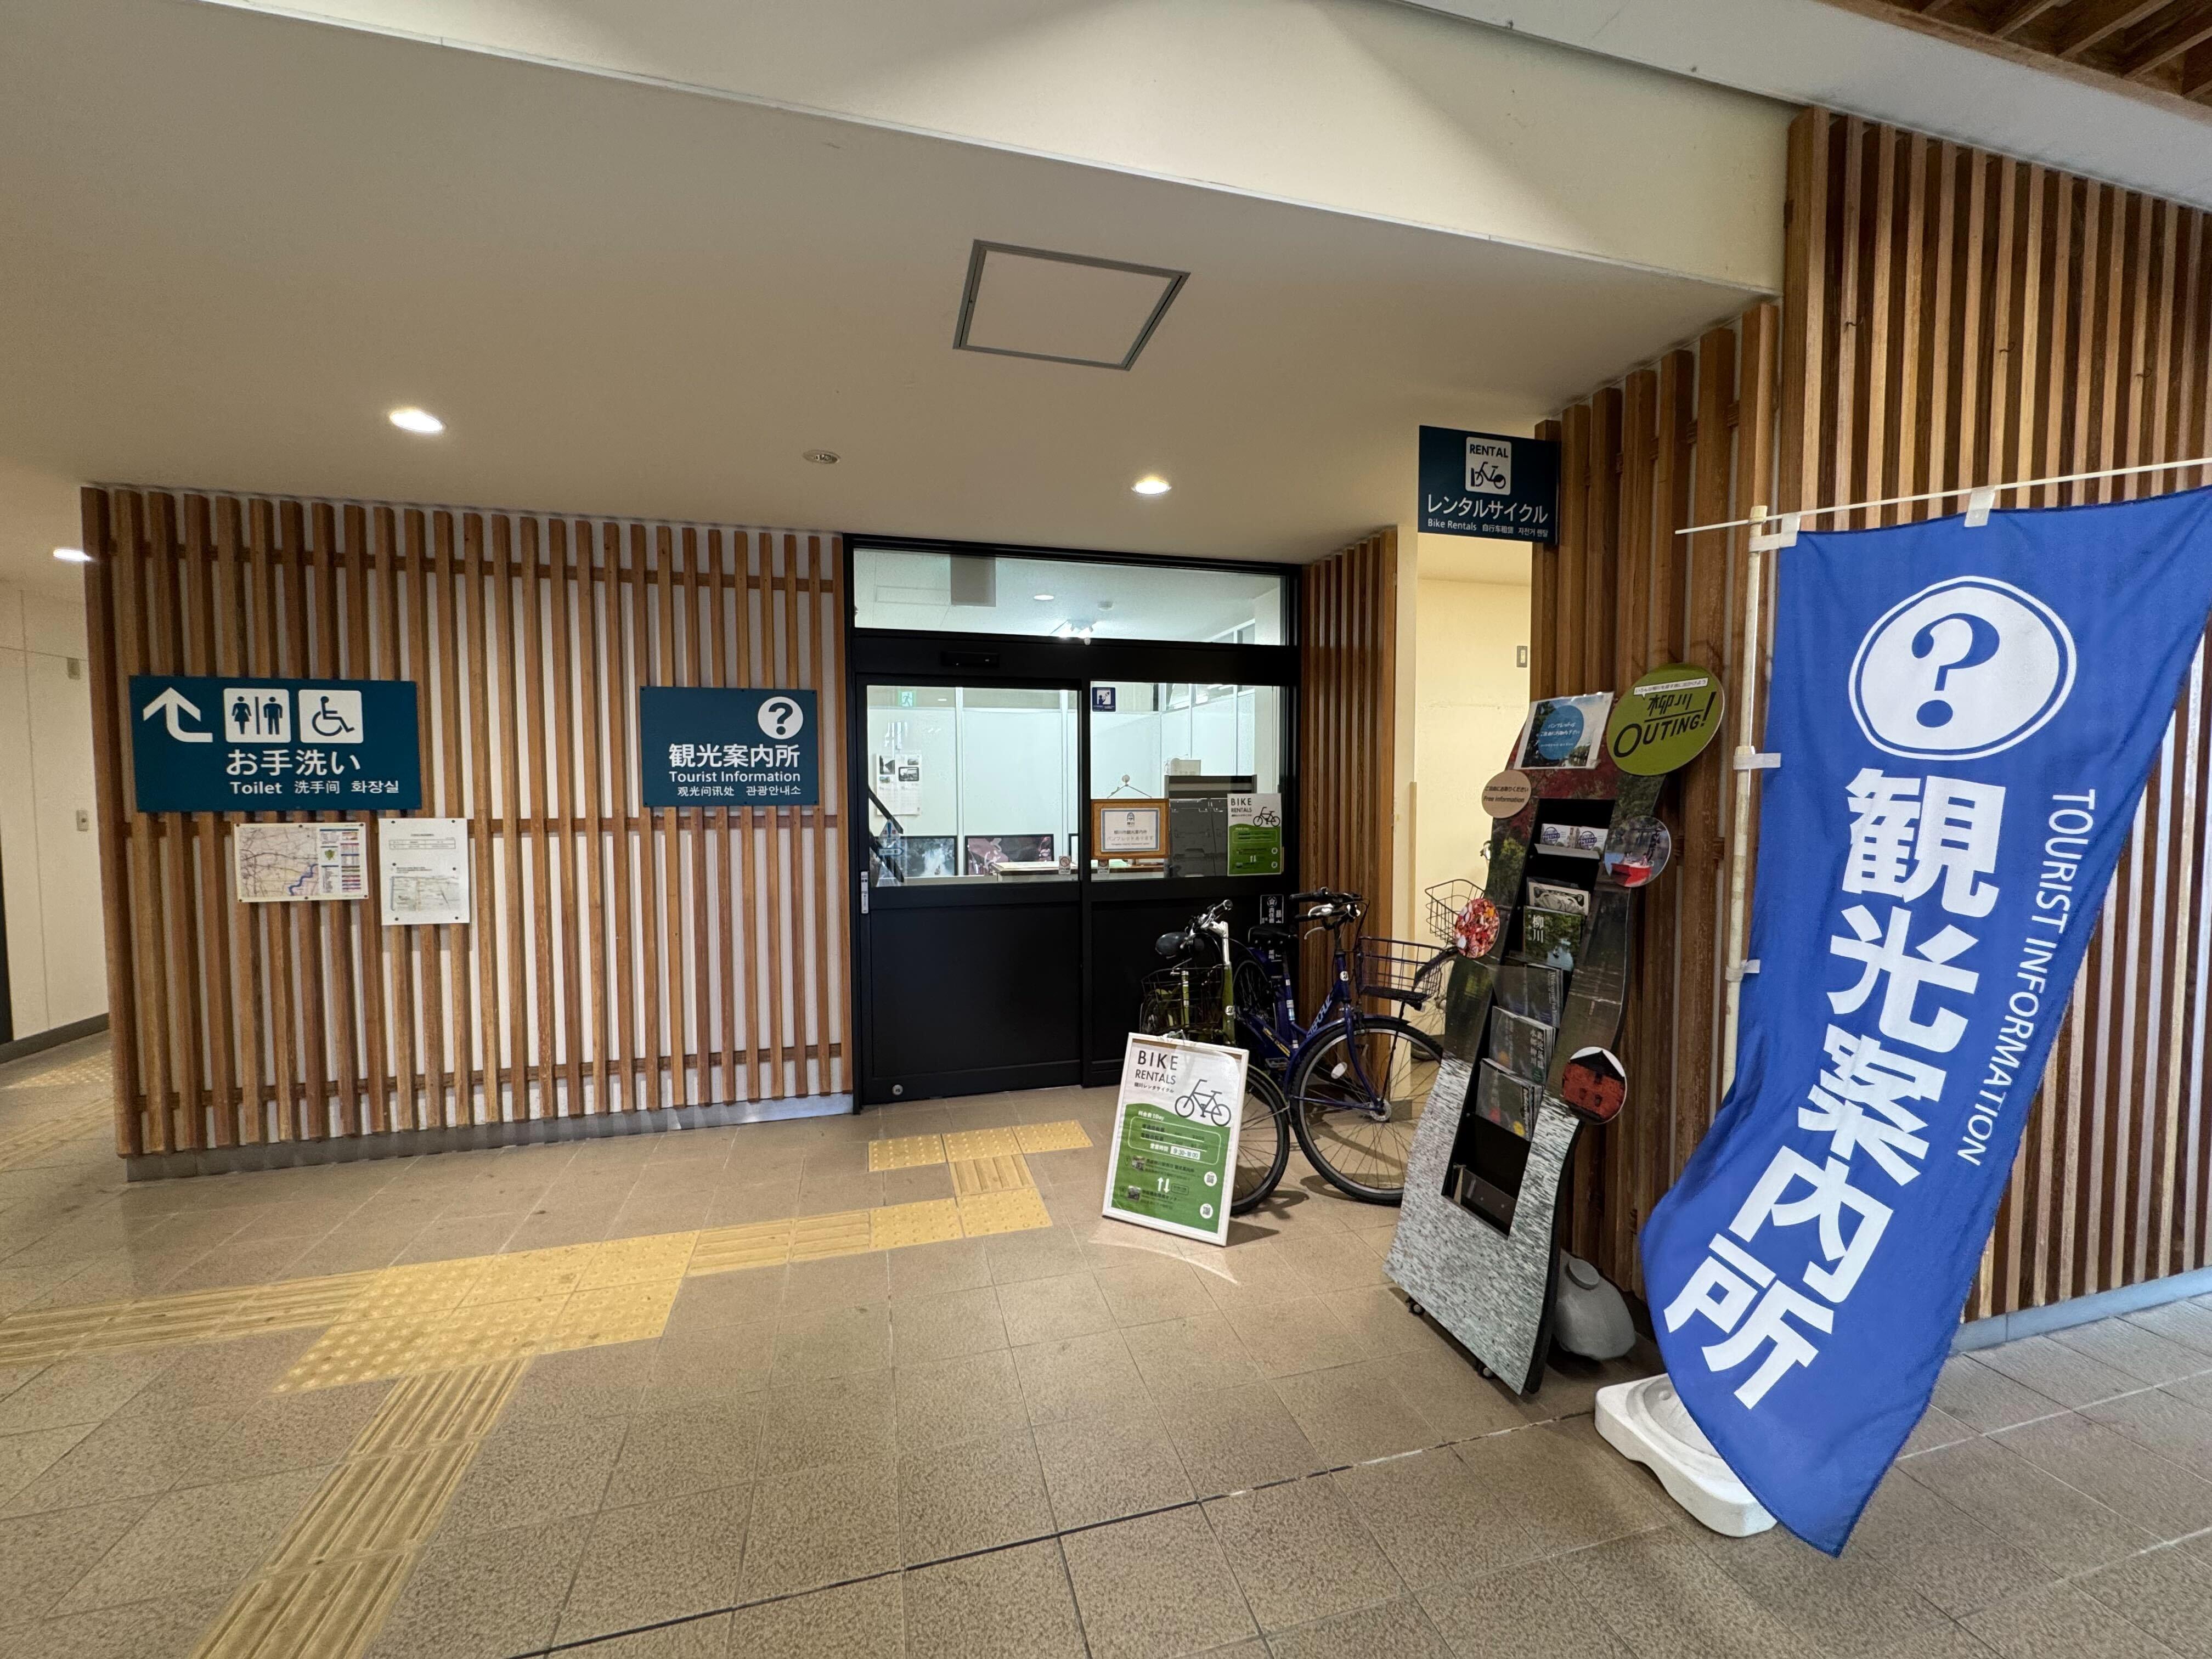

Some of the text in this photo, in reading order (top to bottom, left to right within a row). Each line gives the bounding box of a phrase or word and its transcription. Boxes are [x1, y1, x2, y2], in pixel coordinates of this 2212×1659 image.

[1470, 444, 1508, 458] RENTAL
[1427, 494, 1548, 524] レンタルサイクル
[1427, 518, 1477, 531] Bike Rentals
[1647, 693, 1693, 716] 柳川
[1613, 691, 1717, 758] OUTING!
[226, 749, 360, 776] お手洗い
[669, 743, 800, 768] 観光案内所
[669, 771, 800, 782] Tourist Information
[230, 781, 283, 795] Toilet
[294, 780, 340, 795] 洗手间
[351, 780, 399, 795] 화장실
[677, 786, 735, 797] 观光问讯处
[746, 785, 802, 796] 관광안내소
[1532, 915, 1544, 944] 柳川
[1958, 789, 2095, 1166] TOURIST INFORMATION
[1138, 1050, 1178, 1070] BIKE
[1135, 1069, 1176, 1085] RENTALS
[1664, 765, 2006, 1409] 観光案内所
